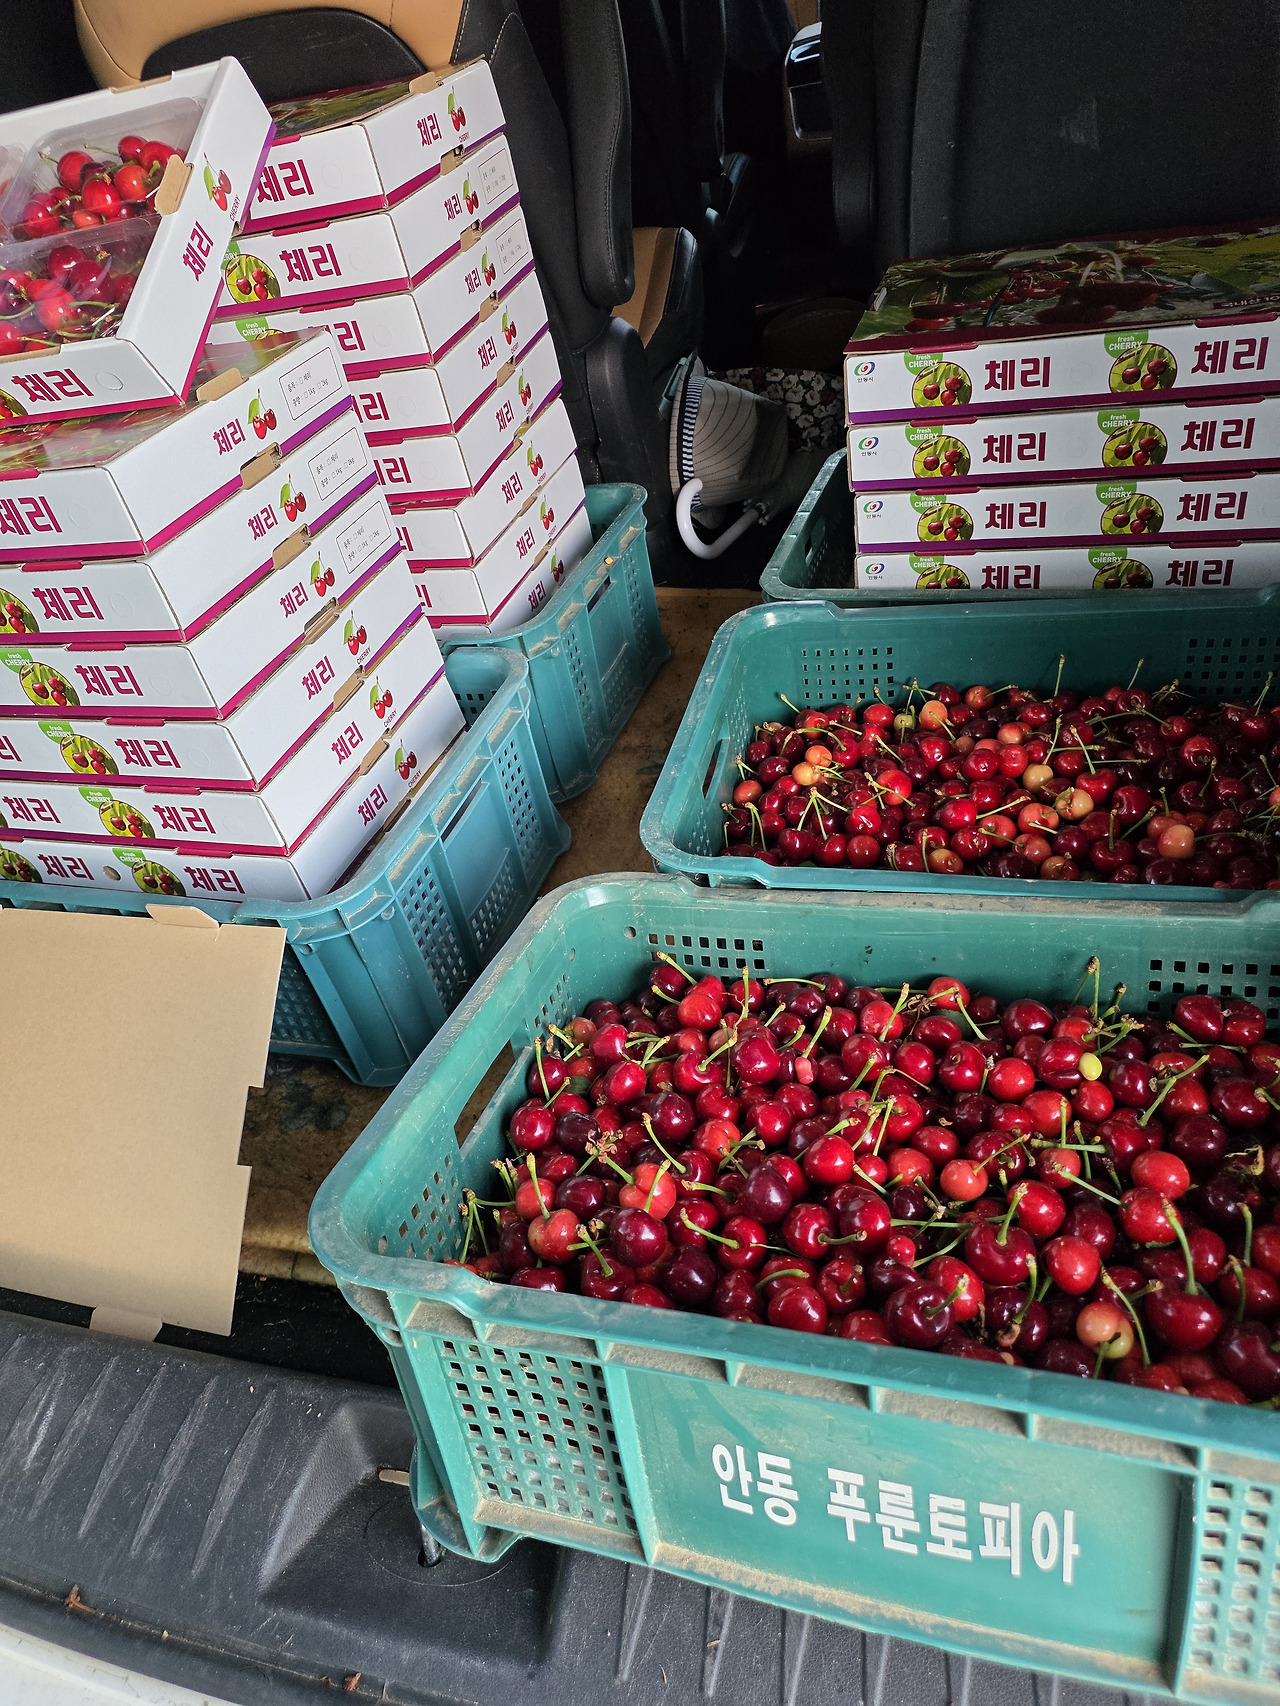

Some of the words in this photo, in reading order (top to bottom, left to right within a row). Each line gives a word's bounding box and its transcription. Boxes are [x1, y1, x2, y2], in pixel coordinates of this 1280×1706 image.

[416, 113, 442, 147] 체리
[230, 194, 240, 221] CHERRY
[443, 193, 463, 221] 체리
[182, 220, 215, 282] 체리
[279, 243, 343, 283] 체리
[464, 268, 482, 294] 체리
[242, 327, 266, 337] CHERRY
[326, 321, 366, 351] 리
[1108, 341, 1142, 351] CHERRY
[478, 336, 498, 369] 체리
[908, 359, 938, 368] CHERRY
[1191, 337, 1269, 374] 체리
[11, 368, 94, 402] 체리
[985, 357, 1051, 391] 체리
[496, 400, 514, 432] 체리
[1102, 419, 1134, 428] CHERRY
[213, 418, 246, 455] 체리
[909, 433, 938, 441] CHERRY
[983, 432, 1047, 464] 체리
[1181, 418, 1255, 451] 체리
[501, 472, 523, 504] 체리
[1100, 491, 1131, 499] CHERRY
[0, 496, 63, 535] 체리
[914, 500, 942, 508] CHERRY
[985, 502, 1046, 529] 체리
[1177, 492, 1248, 521] 체리
[248, 504, 279, 541] 체리
[516, 527, 536, 559] 체리
[981, 565, 1041, 589] 체리
[1166, 560, 1234, 586] 체리
[32, 587, 104, 620] 체리
[279, 582, 309, 618] 체리
[528, 581, 546, 612] 체리
[4, 658, 30, 666] CHERRY
[356, 646, 371, 665] CHERRY
[75, 665, 143, 697] 체리
[302, 655, 336, 700] 체리
[383, 709, 397, 728] CHERRY
[115, 739, 181, 768] 체리
[331, 721, 364, 764] 체리
[407, 769, 422, 788] CHERRY
[2, 796, 61, 823] 체리
[153, 805, 216, 833] 체리
[357, 784, 389, 826] 체리
[38, 854, 94, 880] 체리
[184, 866, 245, 894] 체리
[711, 1443, 799, 1527] 안동
[826, 1467, 1081, 1584] 푸룬토피아
